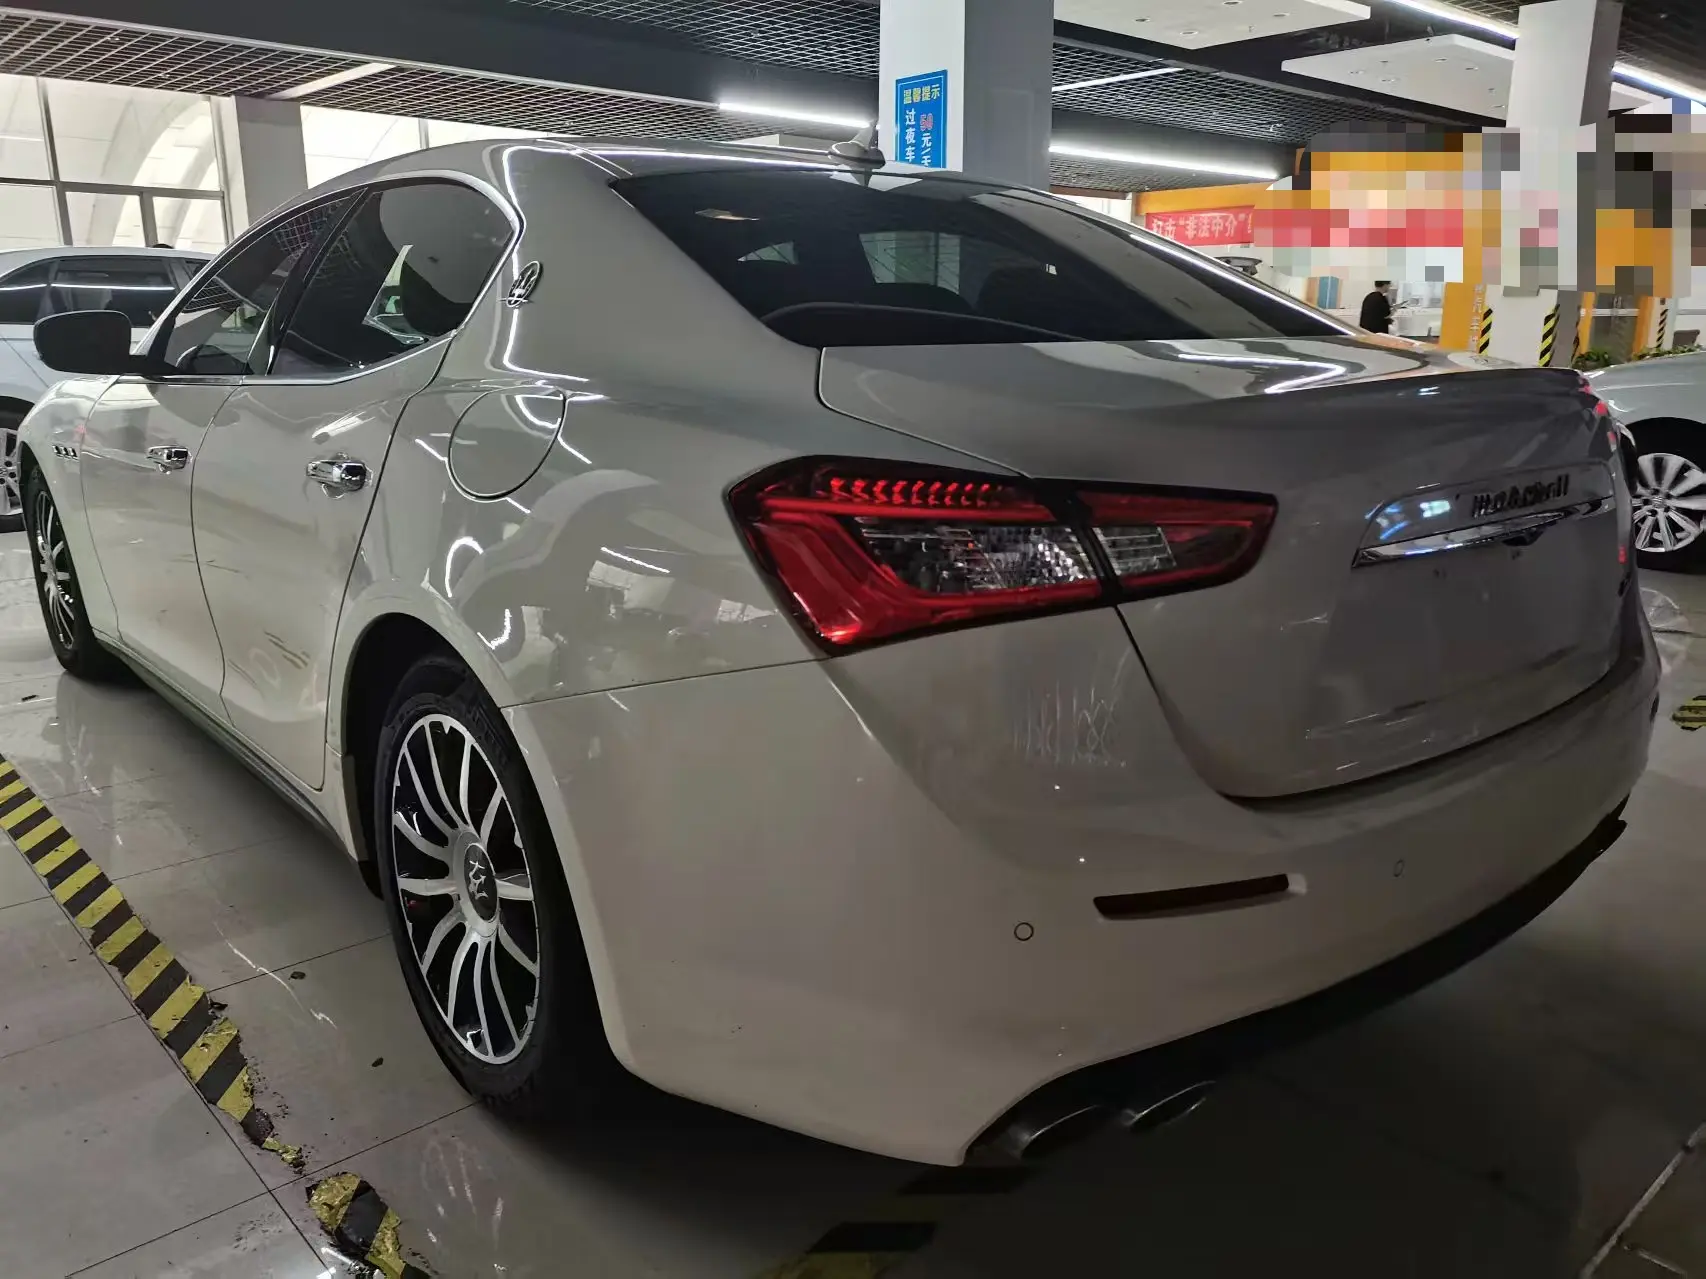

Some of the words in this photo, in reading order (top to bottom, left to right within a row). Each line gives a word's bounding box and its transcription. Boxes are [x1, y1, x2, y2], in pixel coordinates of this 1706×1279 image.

[903, 84, 940, 104] 温馨提示
[905, 108, 916, 163] 过夜车
[1151, 214, 1252, 240] 打击“非法中介”
